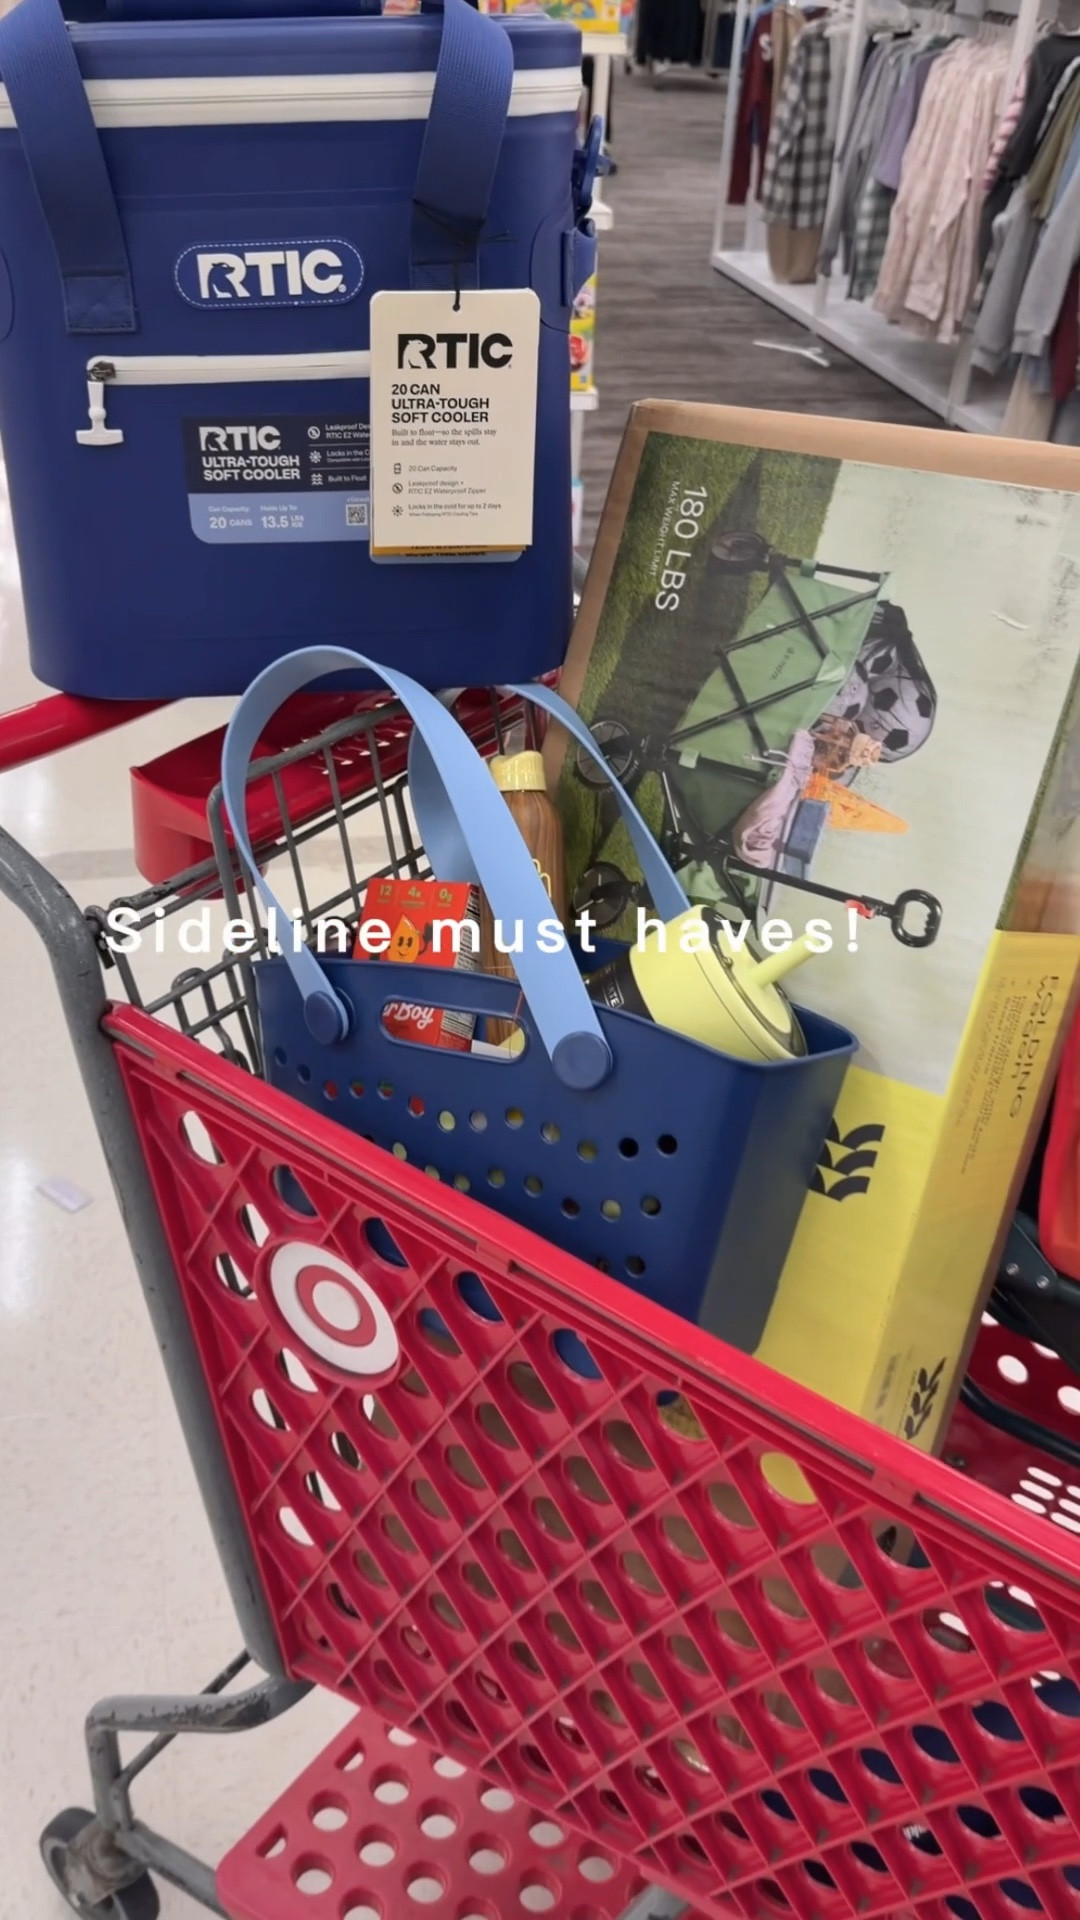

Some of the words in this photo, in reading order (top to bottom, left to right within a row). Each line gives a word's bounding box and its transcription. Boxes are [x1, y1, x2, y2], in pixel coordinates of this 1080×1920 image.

[196, 249, 344, 299] RTIC
[397, 332, 513, 369] RTIC
[391, 384, 408, 395] 20
[410, 384, 441, 395] CAN
[391, 398, 490, 410] ULTRA-TOUGH
[391, 412, 429, 423] SOFT
[431, 411, 489, 423] COOLER
[198, 425, 282, 452] RTIC
[391, 428, 409, 436] Built
[451, 428, 463, 436] the
[464, 428, 482, 437] spills
[483, 429, 497, 437] stay
[449, 439, 466, 447] stays
[202, 455, 300, 468] ULTRA-TOUGH
[203, 469, 242, 481] SOFT
[242, 468, 301, 481] COOLER
[430, 465, 457, 473] Capacity
[667, 480, 681, 504] MAX
[221, 505, 250, 513] Capacity
[674, 485, 708, 539] 180
[208, 516, 227, 529] 20
[228, 518, 253, 527] CANS
[260, 515, 289, 529] 13.5
[656, 505, 673, 549] WEIGHT
[649, 549, 662, 577] LIMIT
[654, 549, 692, 611] LBS
